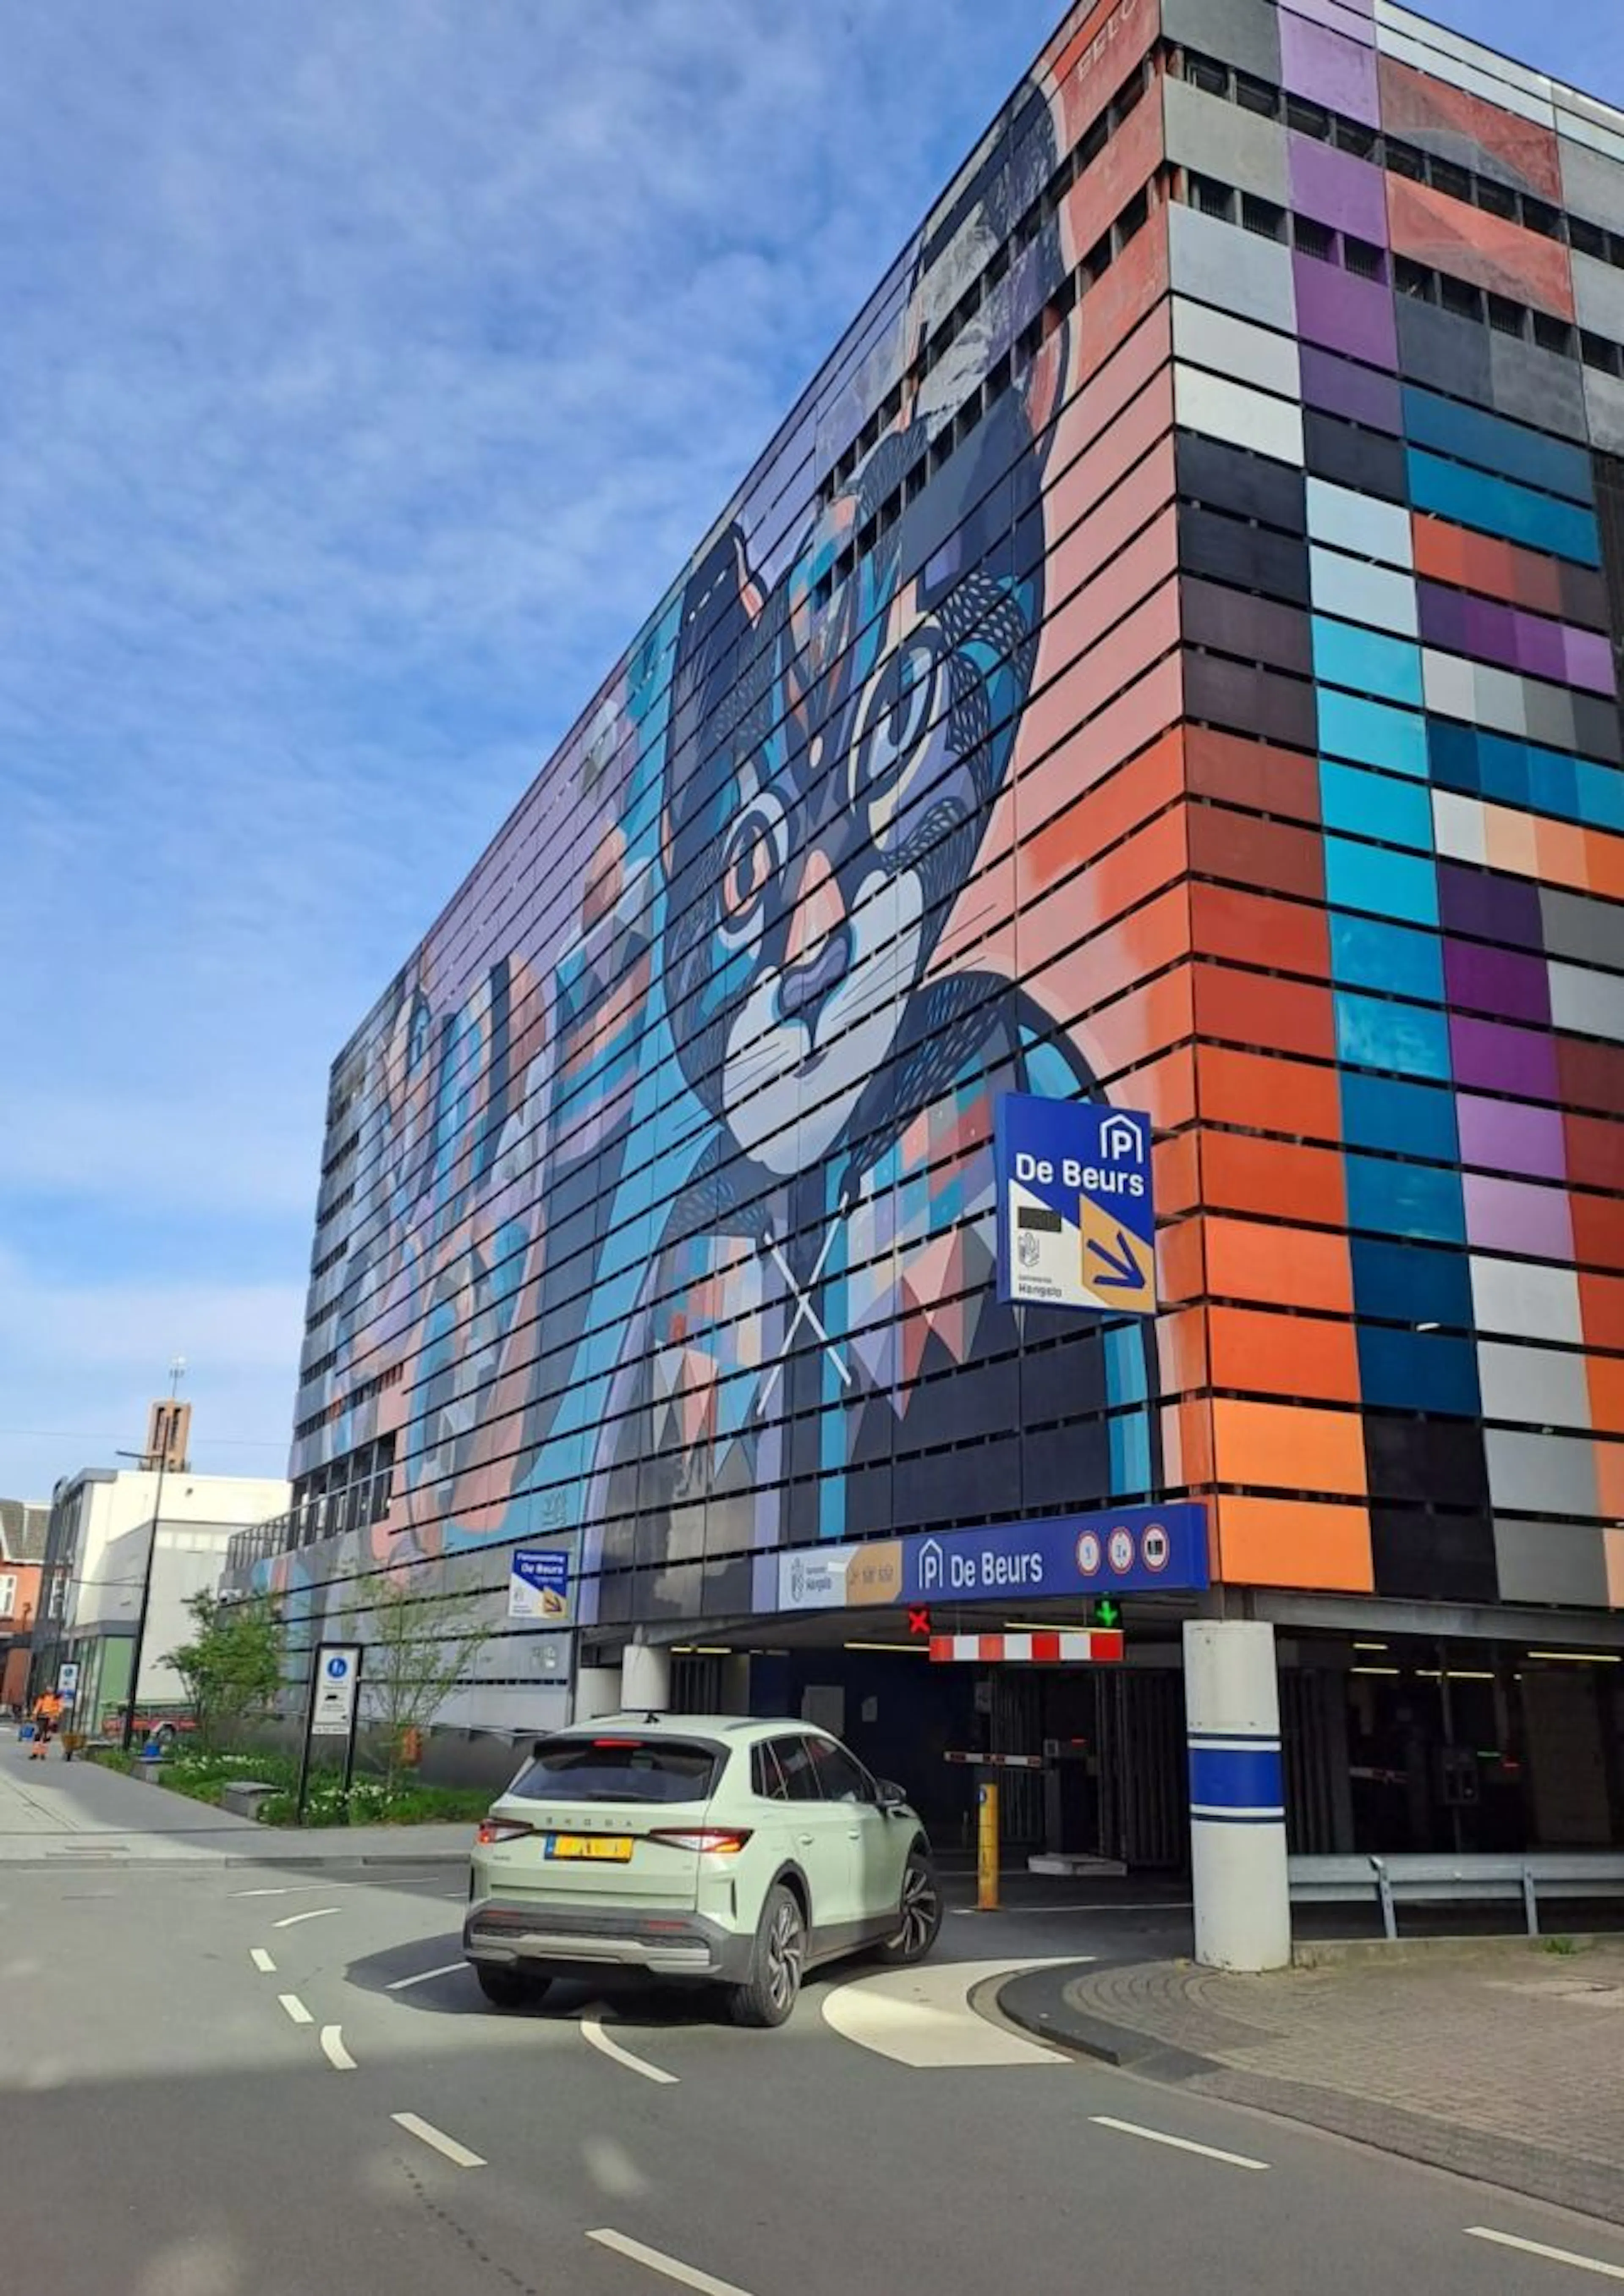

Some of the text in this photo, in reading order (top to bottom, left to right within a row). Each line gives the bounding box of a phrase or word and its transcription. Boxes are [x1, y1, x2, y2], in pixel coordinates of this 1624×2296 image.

[1112, 1130, 1133, 1160] P
[1016, 1152, 1144, 1196] De Beurs
[951, 1551, 1043, 1588] De Beurs
